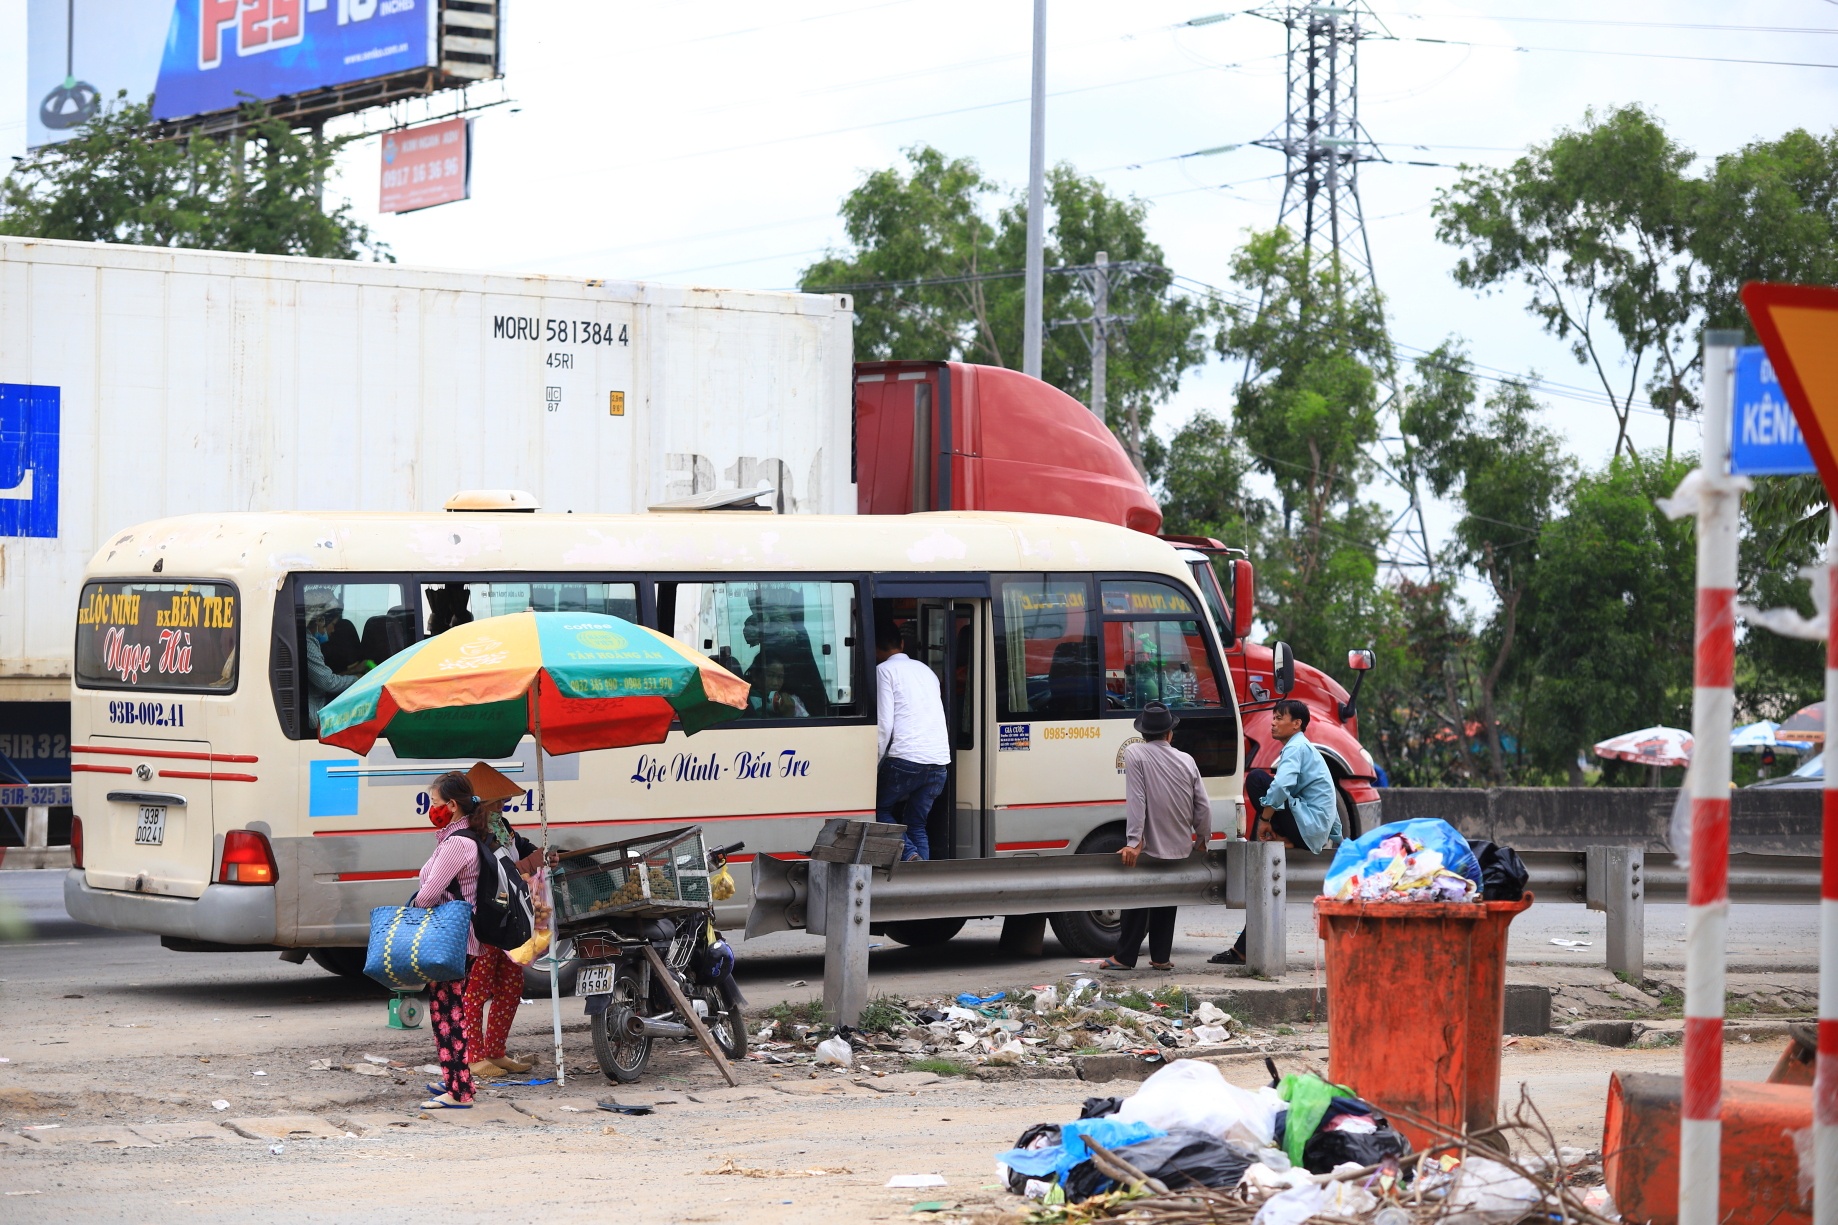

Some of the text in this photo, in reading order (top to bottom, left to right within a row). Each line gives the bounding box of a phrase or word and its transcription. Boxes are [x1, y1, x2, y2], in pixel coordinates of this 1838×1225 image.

[494, 315, 540, 341] MORU
[546, 319, 613, 345] 581384
[546, 353, 573, 369] 45R1
[111, 594, 140, 625] NINH
[203, 596, 234, 628] TRE
[104, 627, 193, 684] Ngọc Hà
[109, 701, 184, 727] 93B-002.41
[630, 753, 667, 790] Lộc
[670, 752, 720, 782] Ninh
[733, 750, 772, 779] Bến
[778, 749, 811, 778] Tre
[144, 808, 159, 824] 93B
